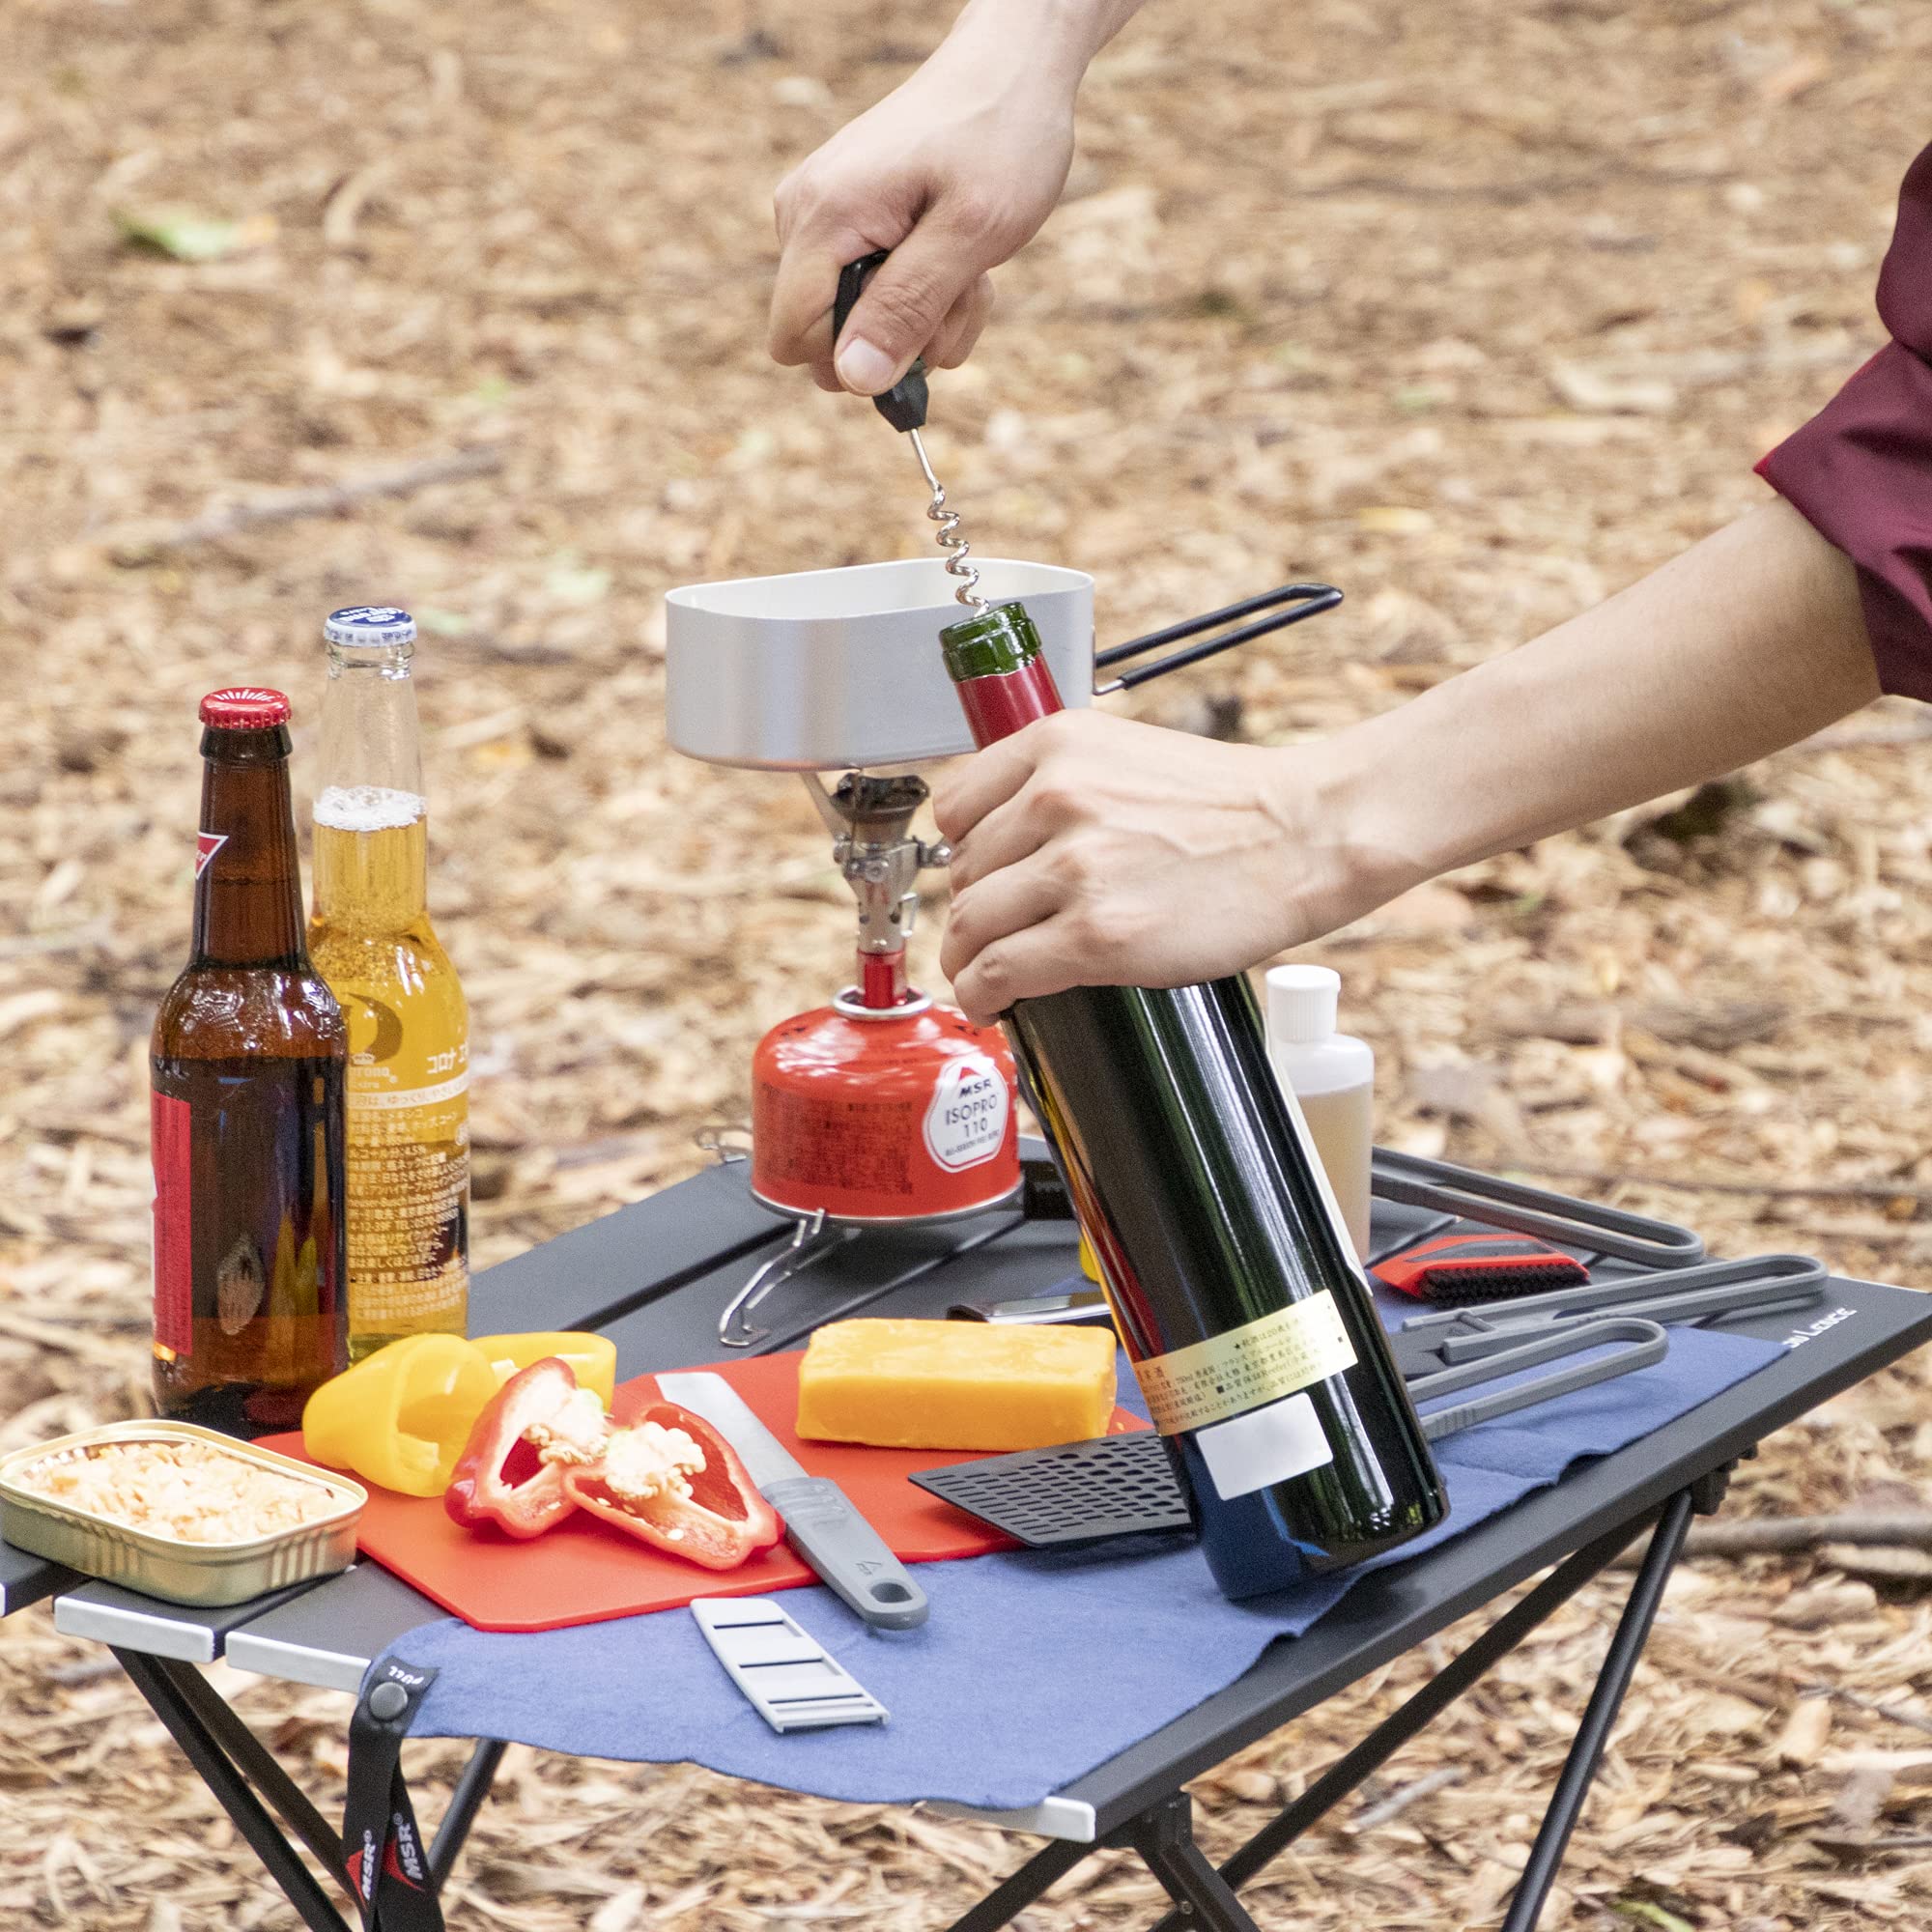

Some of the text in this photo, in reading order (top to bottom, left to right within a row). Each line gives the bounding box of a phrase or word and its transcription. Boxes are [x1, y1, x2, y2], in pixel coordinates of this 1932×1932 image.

[958, 1079, 992, 1098] MSR
[946, 1094, 998, 1125] ISOPRO
[964, 1118, 988, 1137] 110
